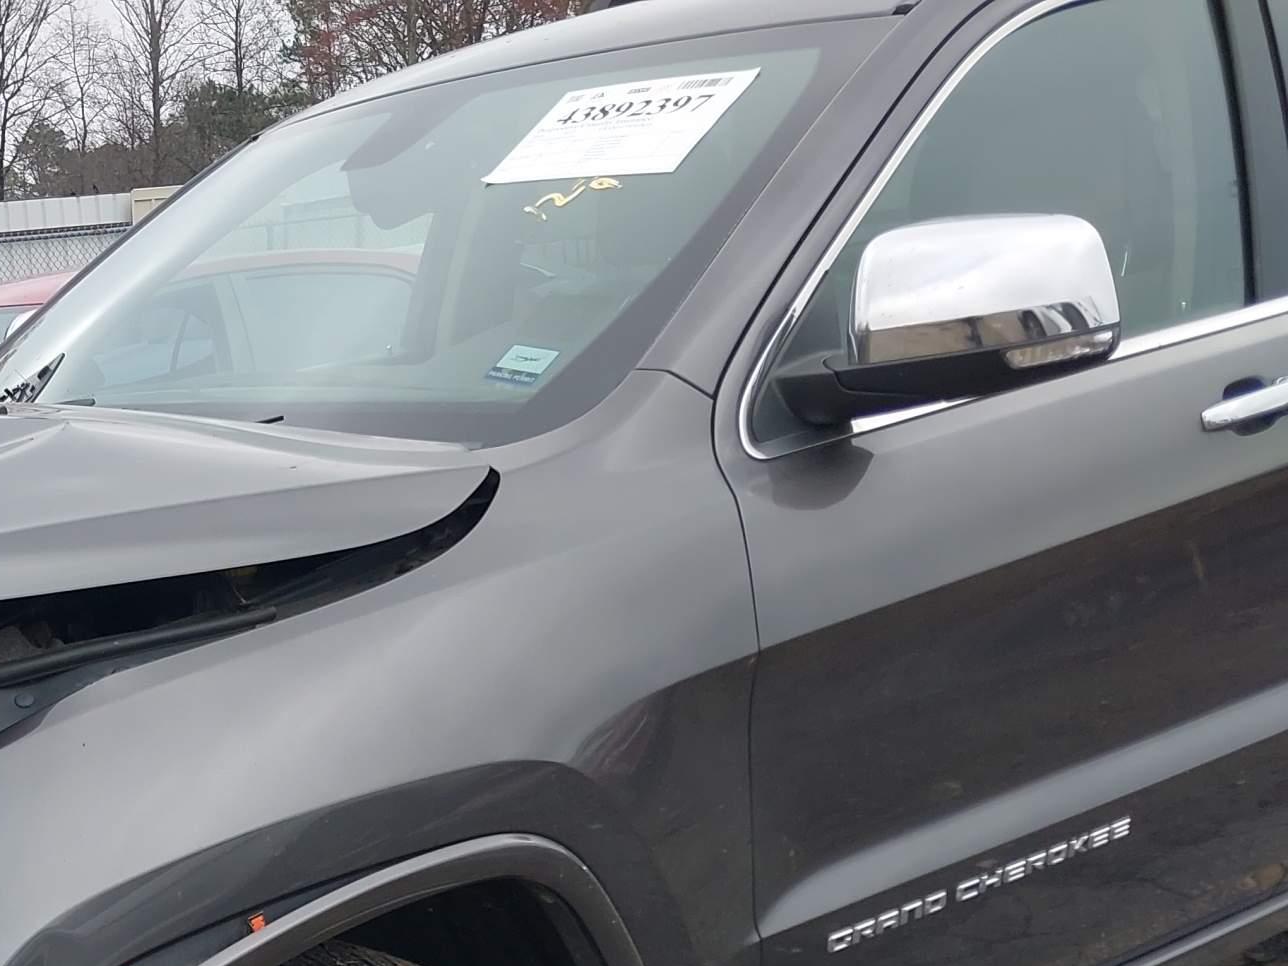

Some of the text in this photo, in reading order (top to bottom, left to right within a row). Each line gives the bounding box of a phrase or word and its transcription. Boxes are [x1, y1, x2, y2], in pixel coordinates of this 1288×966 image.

[557, 94, 716, 125] 43892397
[827, 815, 1132, 953] GRAND CHEROKEE
